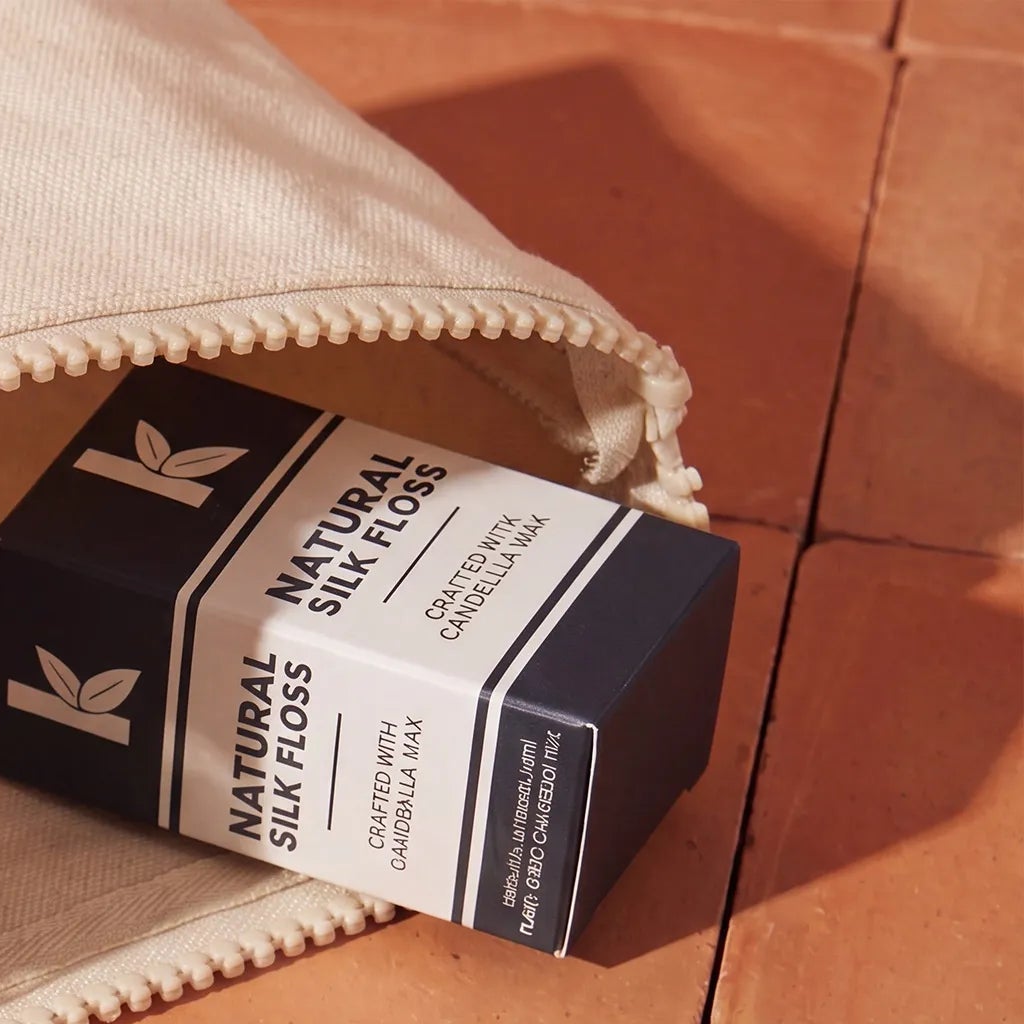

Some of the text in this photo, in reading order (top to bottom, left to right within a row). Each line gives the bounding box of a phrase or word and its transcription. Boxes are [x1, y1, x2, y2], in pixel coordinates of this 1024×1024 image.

[263, 453, 415, 606] NATURAL
[307, 463, 448, 617] SILK FLOSS
[228, 653, 277, 841] NATURAL
[269, 660, 313, 852] SILK FLOSS
[367, 720, 398, 850] CRAFTED WITH
[402, 715, 424, 761] MAX
